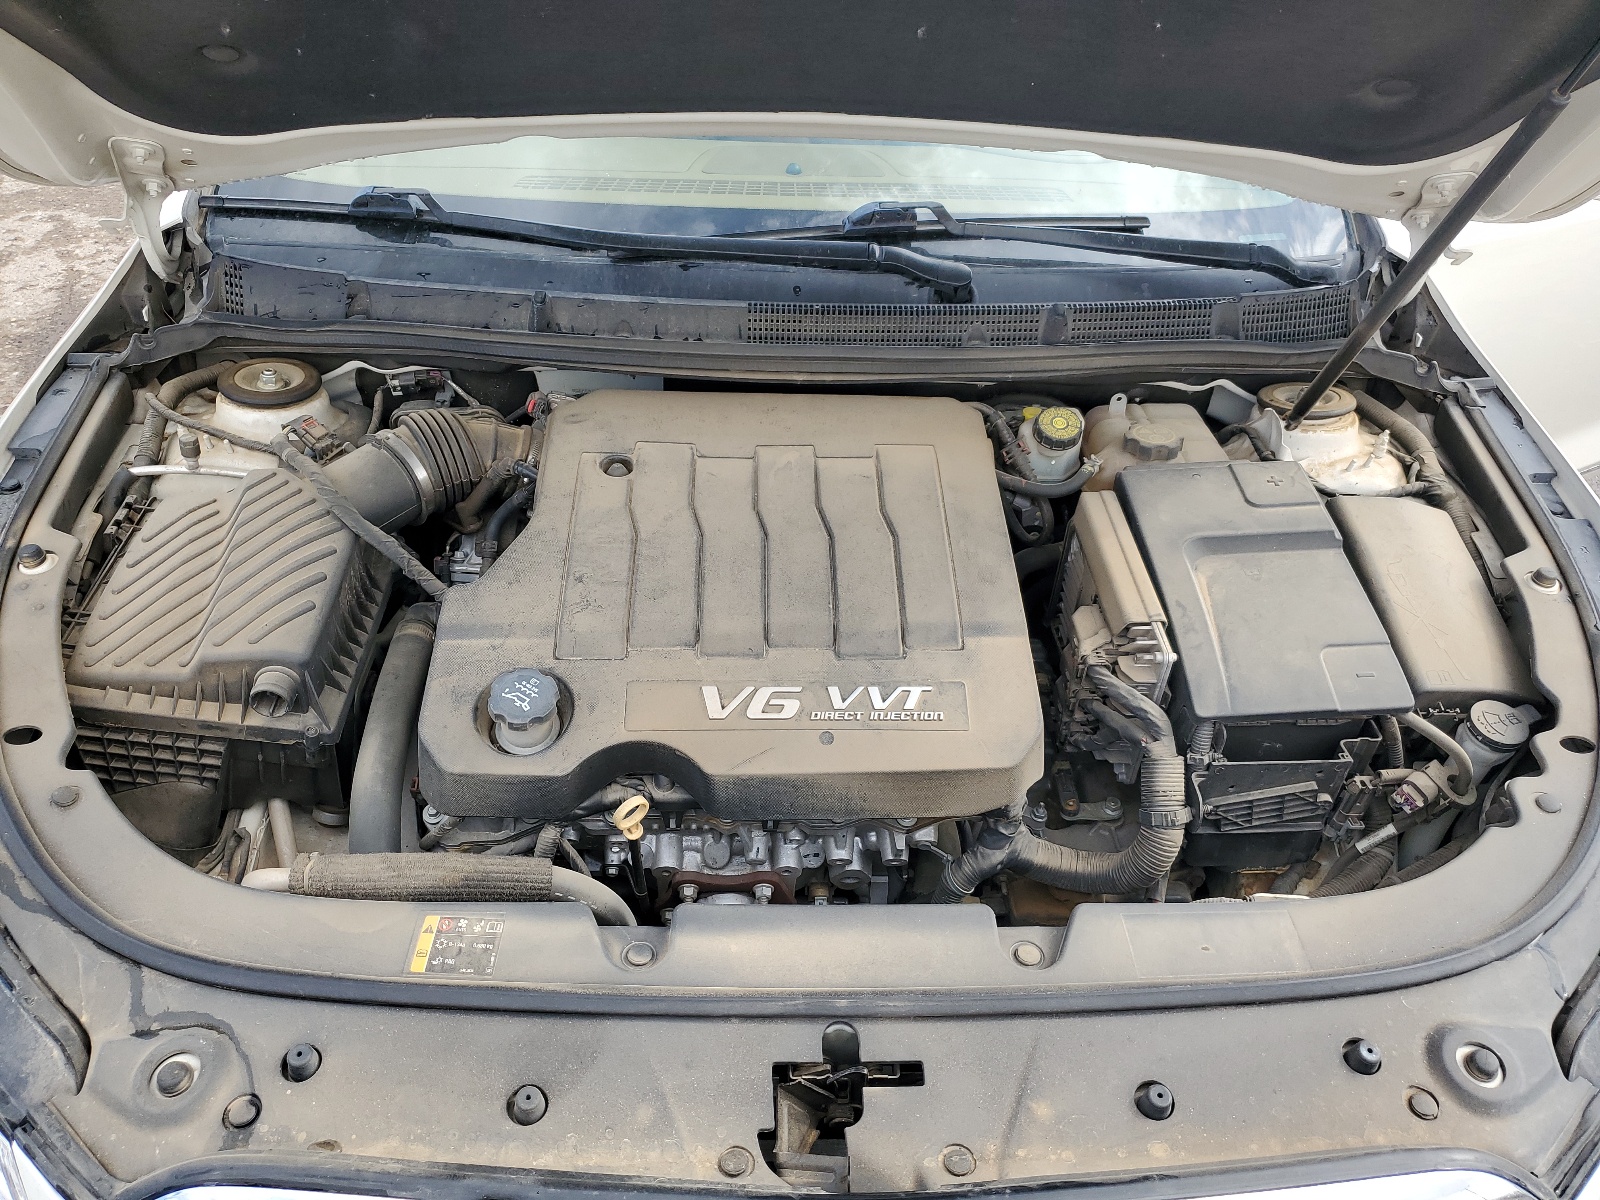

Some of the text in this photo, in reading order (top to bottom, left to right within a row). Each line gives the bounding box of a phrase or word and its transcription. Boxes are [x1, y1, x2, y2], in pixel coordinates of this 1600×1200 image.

[701, 685, 933, 720] V6 VVT
[810, 711, 944, 721] DIRECT INJECTION
